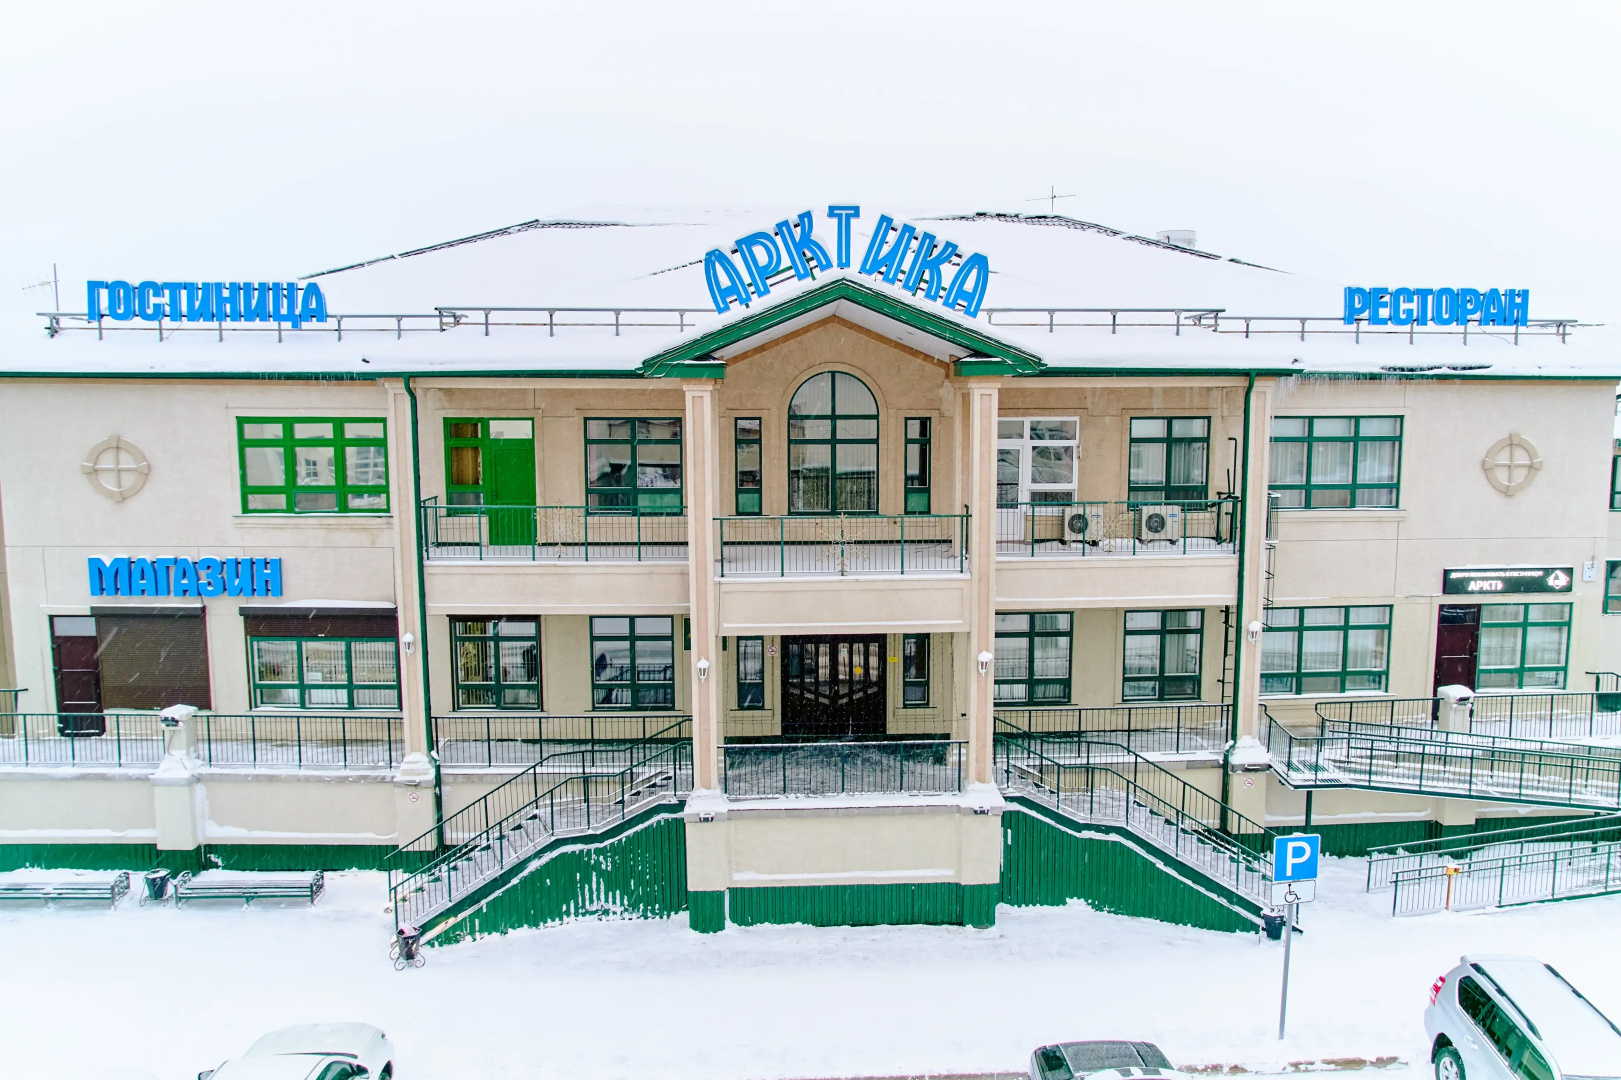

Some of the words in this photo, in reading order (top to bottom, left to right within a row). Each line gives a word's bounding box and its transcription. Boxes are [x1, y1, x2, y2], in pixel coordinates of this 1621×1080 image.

[704, 204, 989, 318] АРКТИКА
[87, 280, 328, 329] ГОСТИНИЦА
[1343, 286, 1529, 327] РЕСТОРАН
[88, 556, 283, 597] МАГАЗИН
[1286, 841, 1311, 876] P
